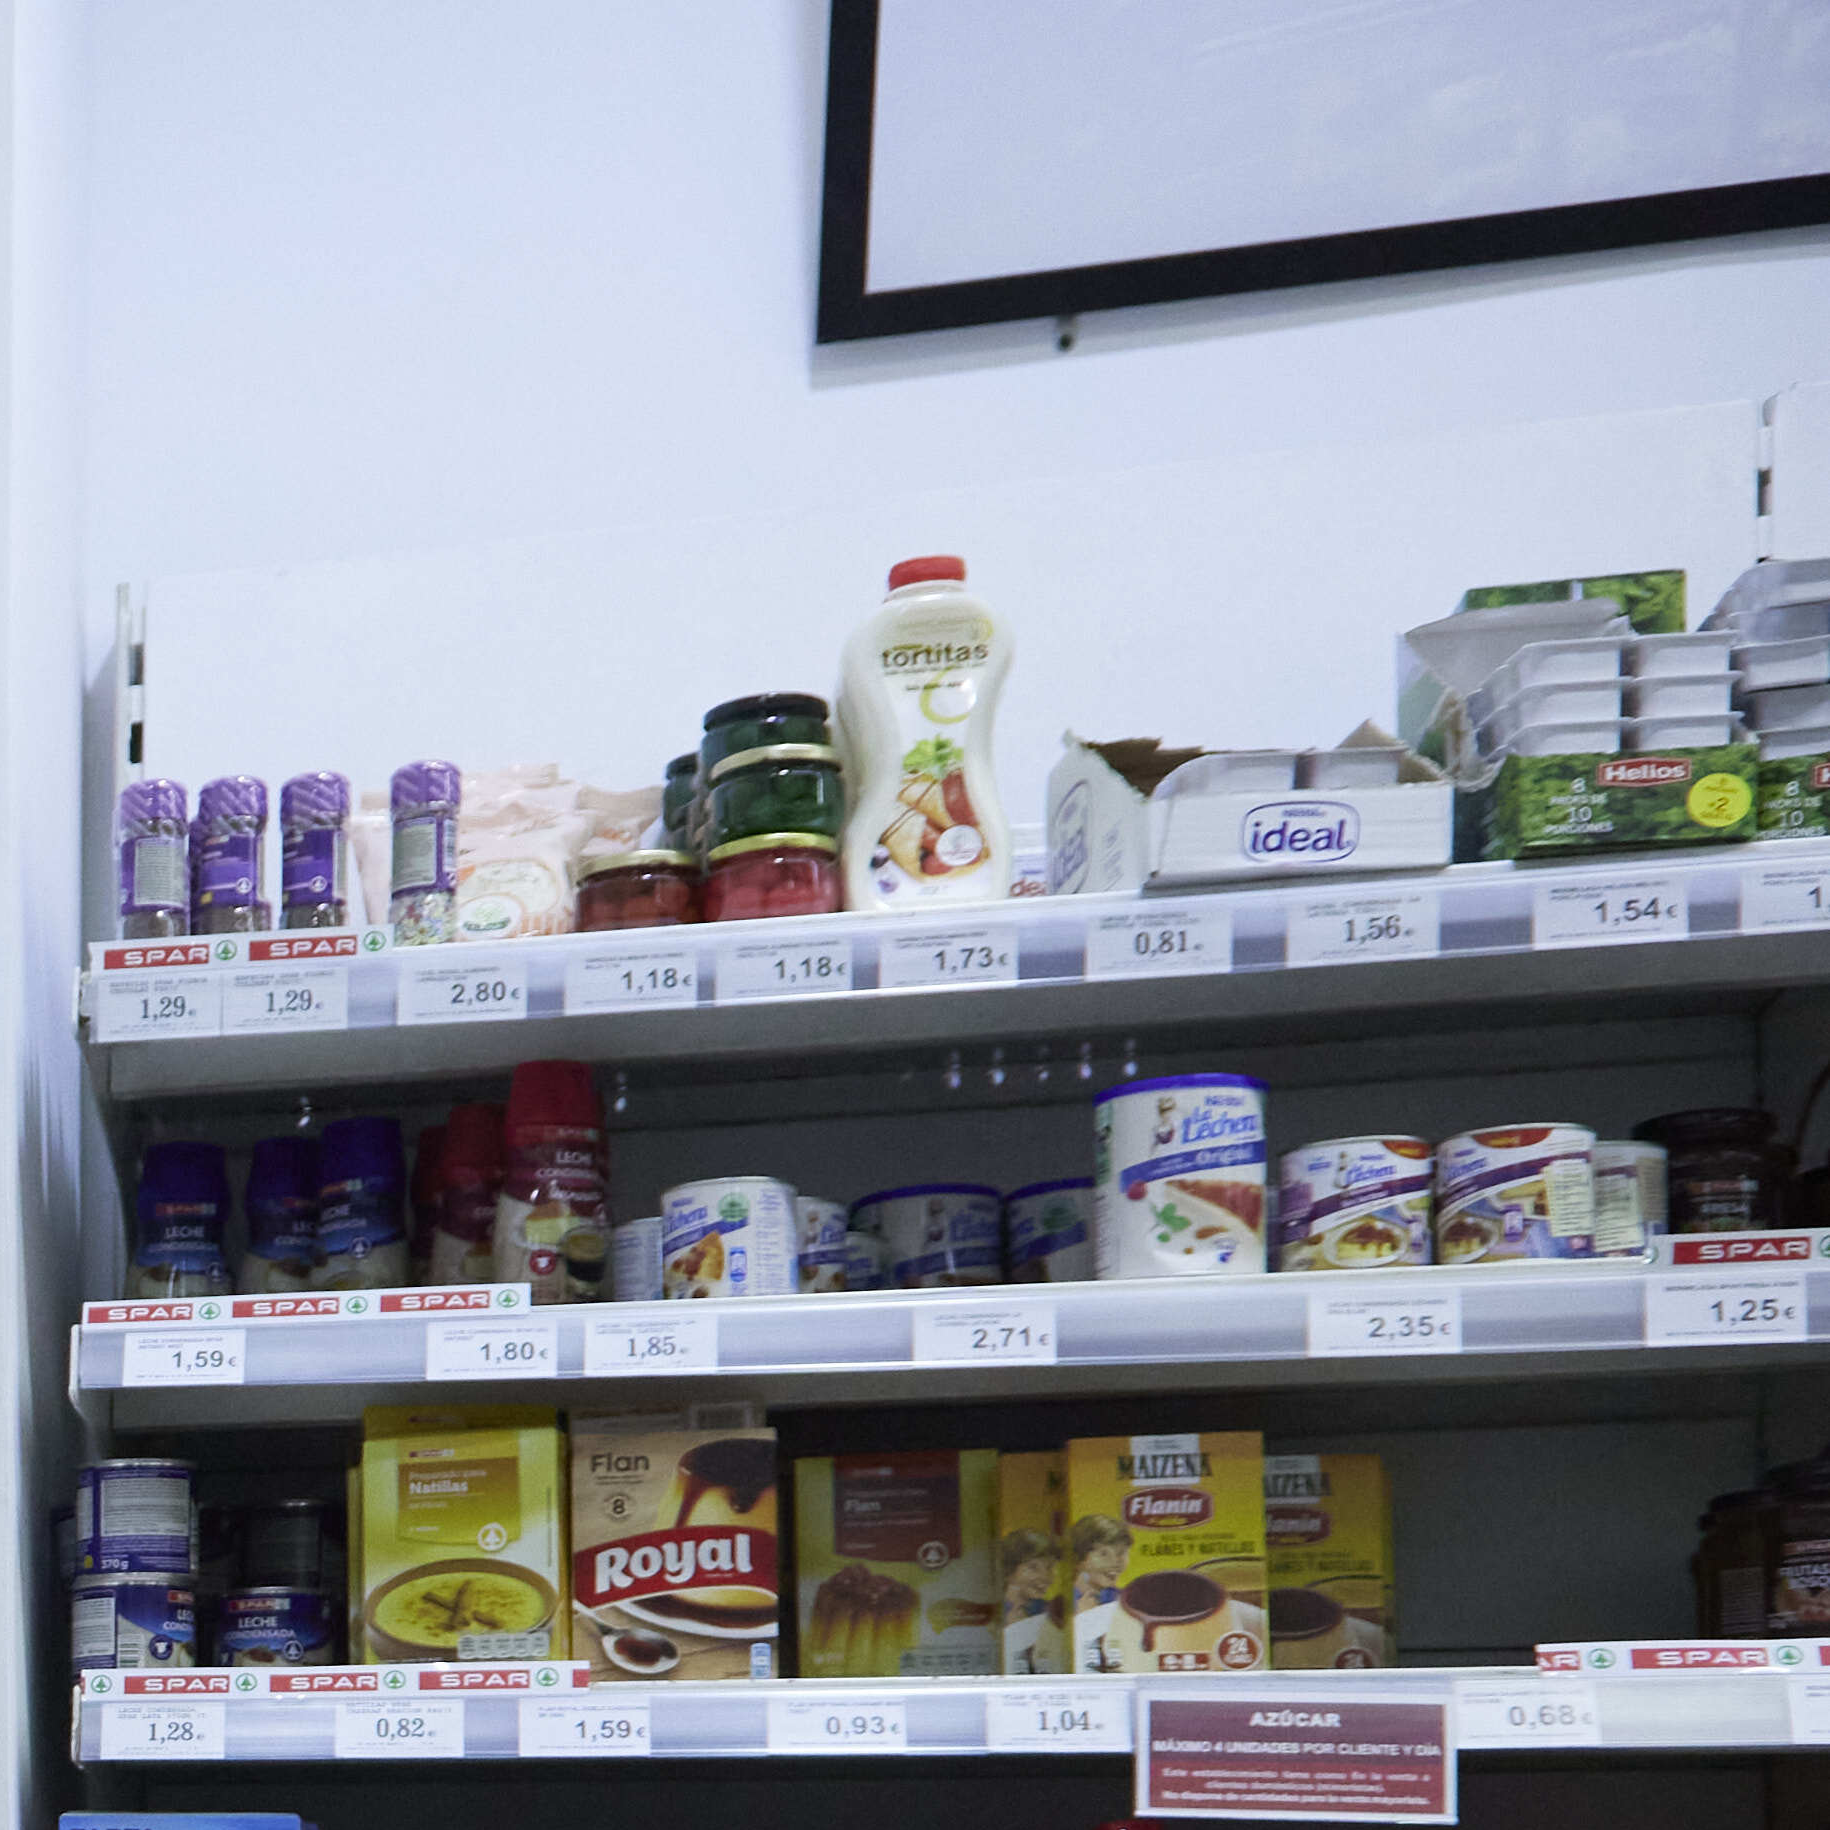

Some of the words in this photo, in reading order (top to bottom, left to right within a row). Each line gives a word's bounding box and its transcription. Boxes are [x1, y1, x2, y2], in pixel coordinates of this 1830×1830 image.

[881, 643, 989, 668] tortitas
[1605, 762, 1686, 781] Helios
[1569, 806, 1592, 823] 10
[1250, 818, 1347, 855] ideal
[124, 946, 209, 965] SPAR
[269, 937, 356, 957] SPAR
[1699, 1242, 1809, 1260] SPAR
[252, 1299, 339, 1316] SPAR
[400, 1292, 490, 1310] SPAR
[107, 1306, 193, 1321] SPAR
[590, 1454, 650, 1474] Flan
[408, 1479, 468, 1495] Natillas
[612, 1499, 625, 1515] 8
[595, 1533, 752, 1594] Royal
[239, 1617, 278, 1627] LECHE
[1656, 1651, 1767, 1666] SPAR
[144, 1677, 228, 1691] SPAR
[289, 1674, 377, 1689] SPAR
[440, 1671, 529, 1687] SPAR
[1250, 1709, 1341, 1727] AZÚCAR
[1225, 1741, 1300, 1754] UNIDADES
[1303, 1743, 1335, 1754] POR
[1338, 1743, 1399, 1755] CLIENTE
[1403, 1744, 1412, 1755] Y
